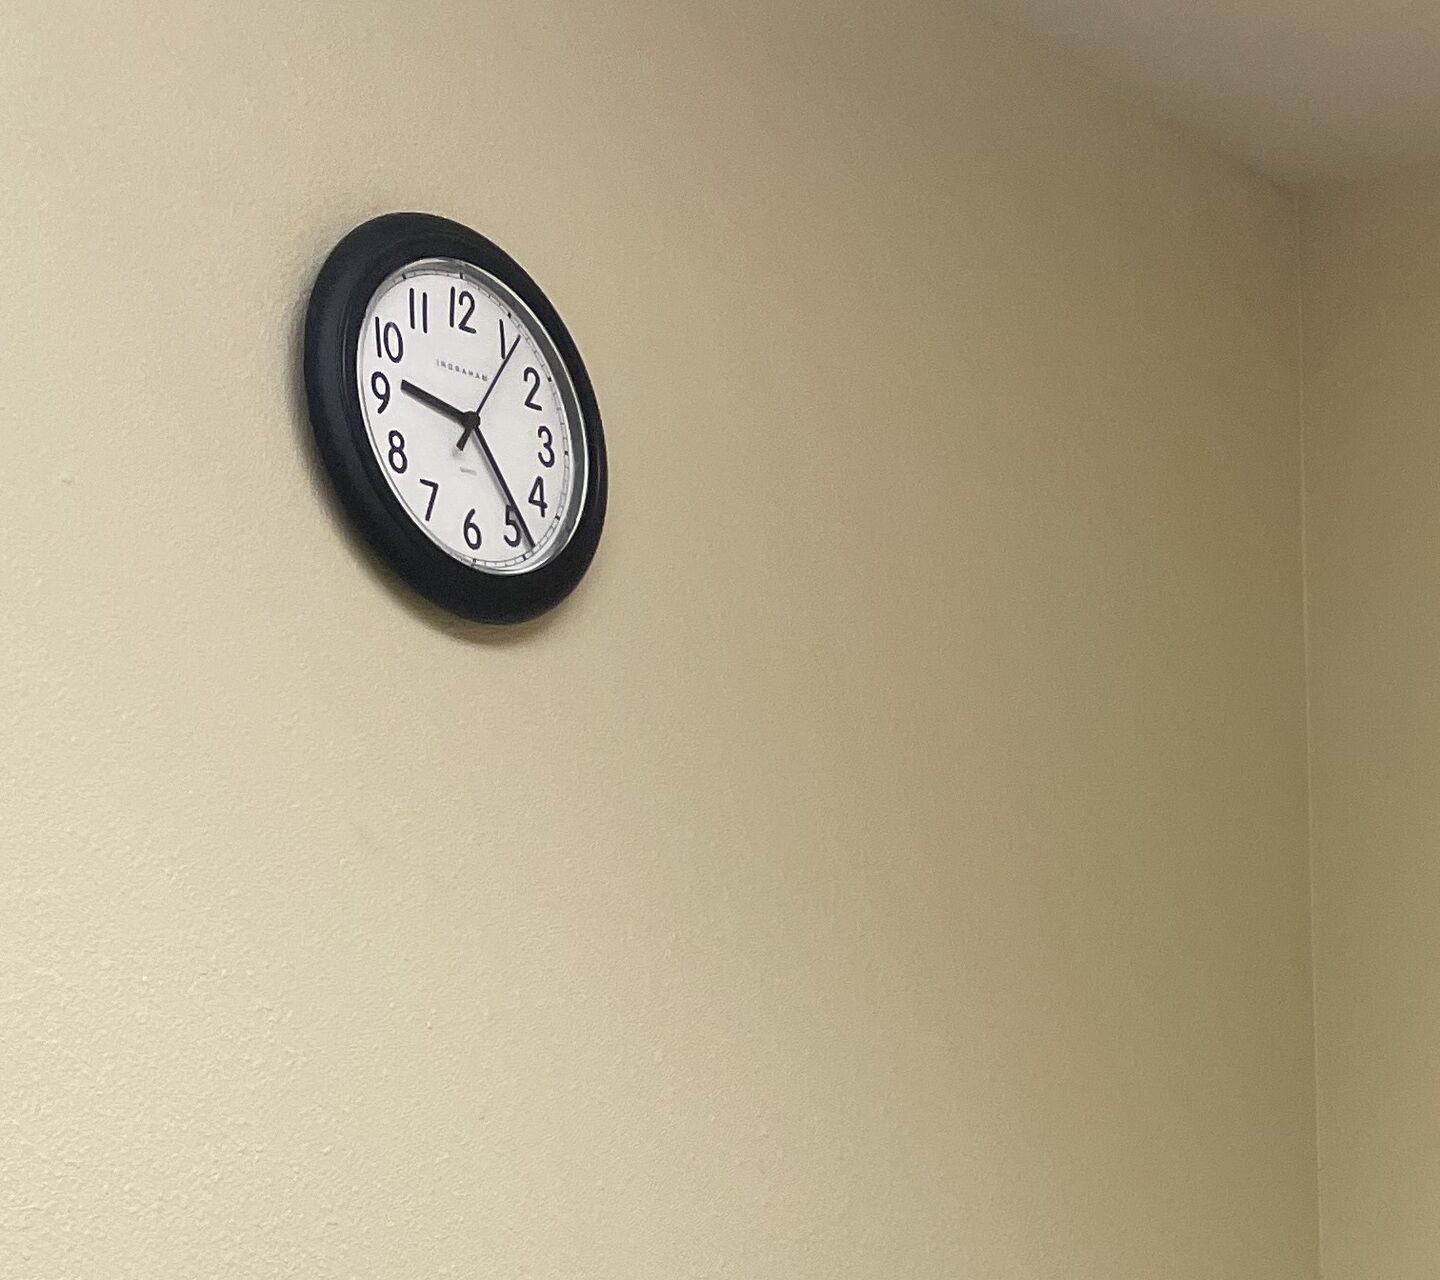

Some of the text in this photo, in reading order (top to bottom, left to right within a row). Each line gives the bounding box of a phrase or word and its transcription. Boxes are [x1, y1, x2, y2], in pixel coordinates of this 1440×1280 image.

[409, 287, 428, 334] 11
[449, 286, 477, 334] 12
[375, 316, 404, 364] 10
[499, 318, 506, 360] 1
[371, 371, 391, 415] 9
[523, 366, 542, 411] 2
[388, 430, 408, 474] 8
[537, 425, 555, 468] 3
[420, 478, 439, 522] 7
[528, 476, 548, 518] 4
[463, 508, 482, 550] 6
[503, 504, 522, 548] 5
